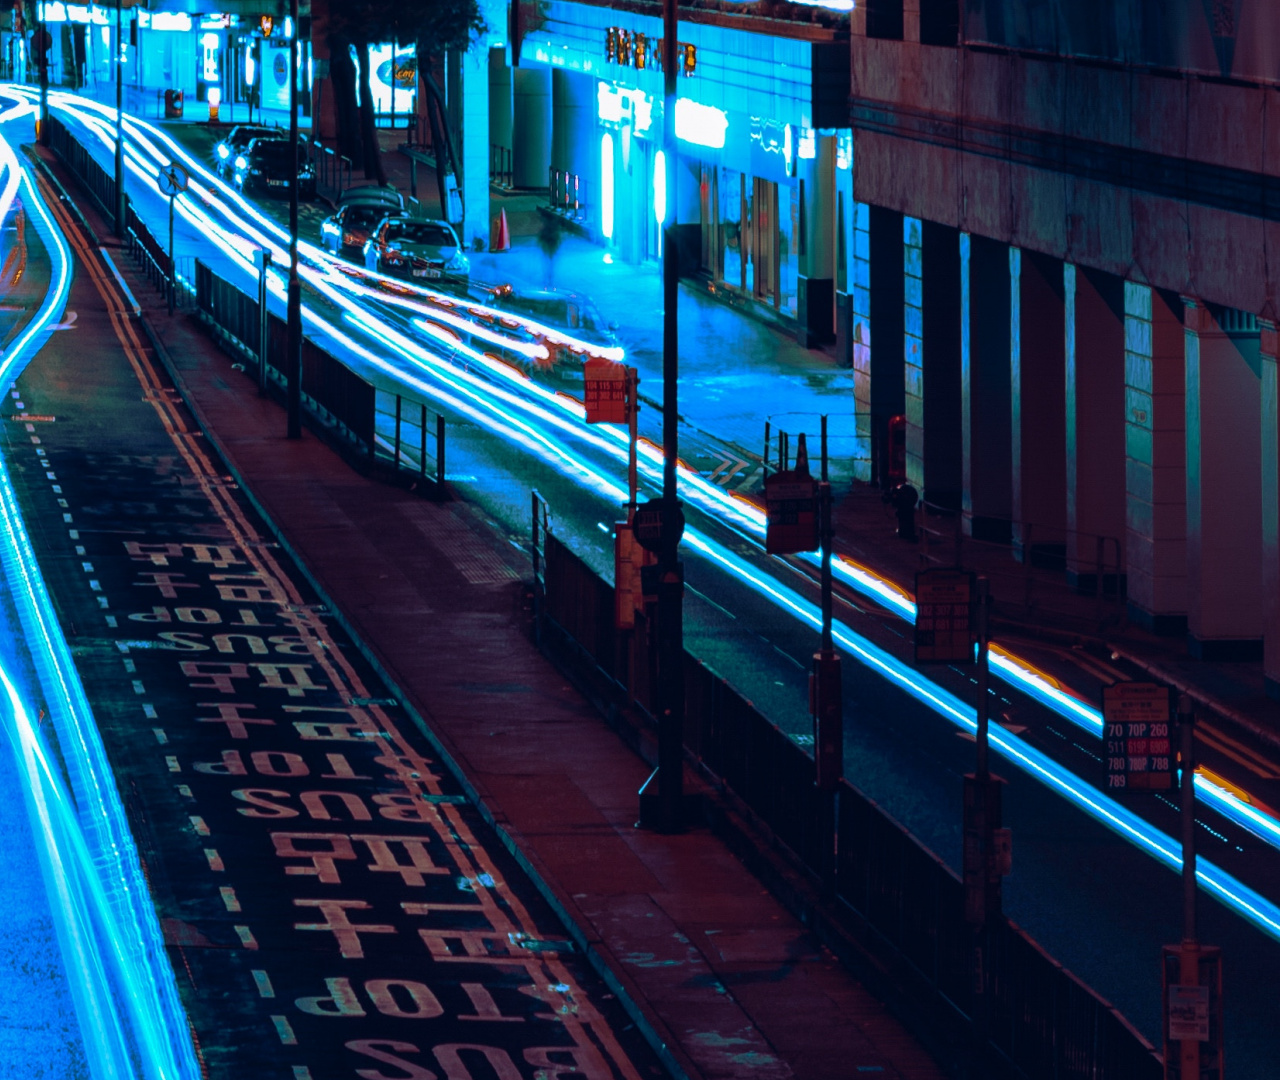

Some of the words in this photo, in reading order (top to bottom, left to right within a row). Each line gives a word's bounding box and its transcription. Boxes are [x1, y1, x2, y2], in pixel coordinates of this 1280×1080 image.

[123, 541, 247, 568] 站
[132, 572, 289, 603] 巴士
[157, 631, 324, 655] BUS
[178, 660, 328, 698] 站
[194, 703, 378, 742] 巴士
[1108, 723, 1123, 737] 70
[1127, 723, 1147, 737] 70P
[1150, 723, 1168, 737] 260
[1107, 740, 1124, 754] 511
[1108, 757, 1125, 771] 780
[1129, 757, 1147, 771] 780P
[1151, 757, 1169, 771] 788
[1108, 774, 1126, 788] 789
[231, 788, 438, 823] BUS
[270, 831, 451, 887] 站
[293, 899, 548, 964] 巴士
